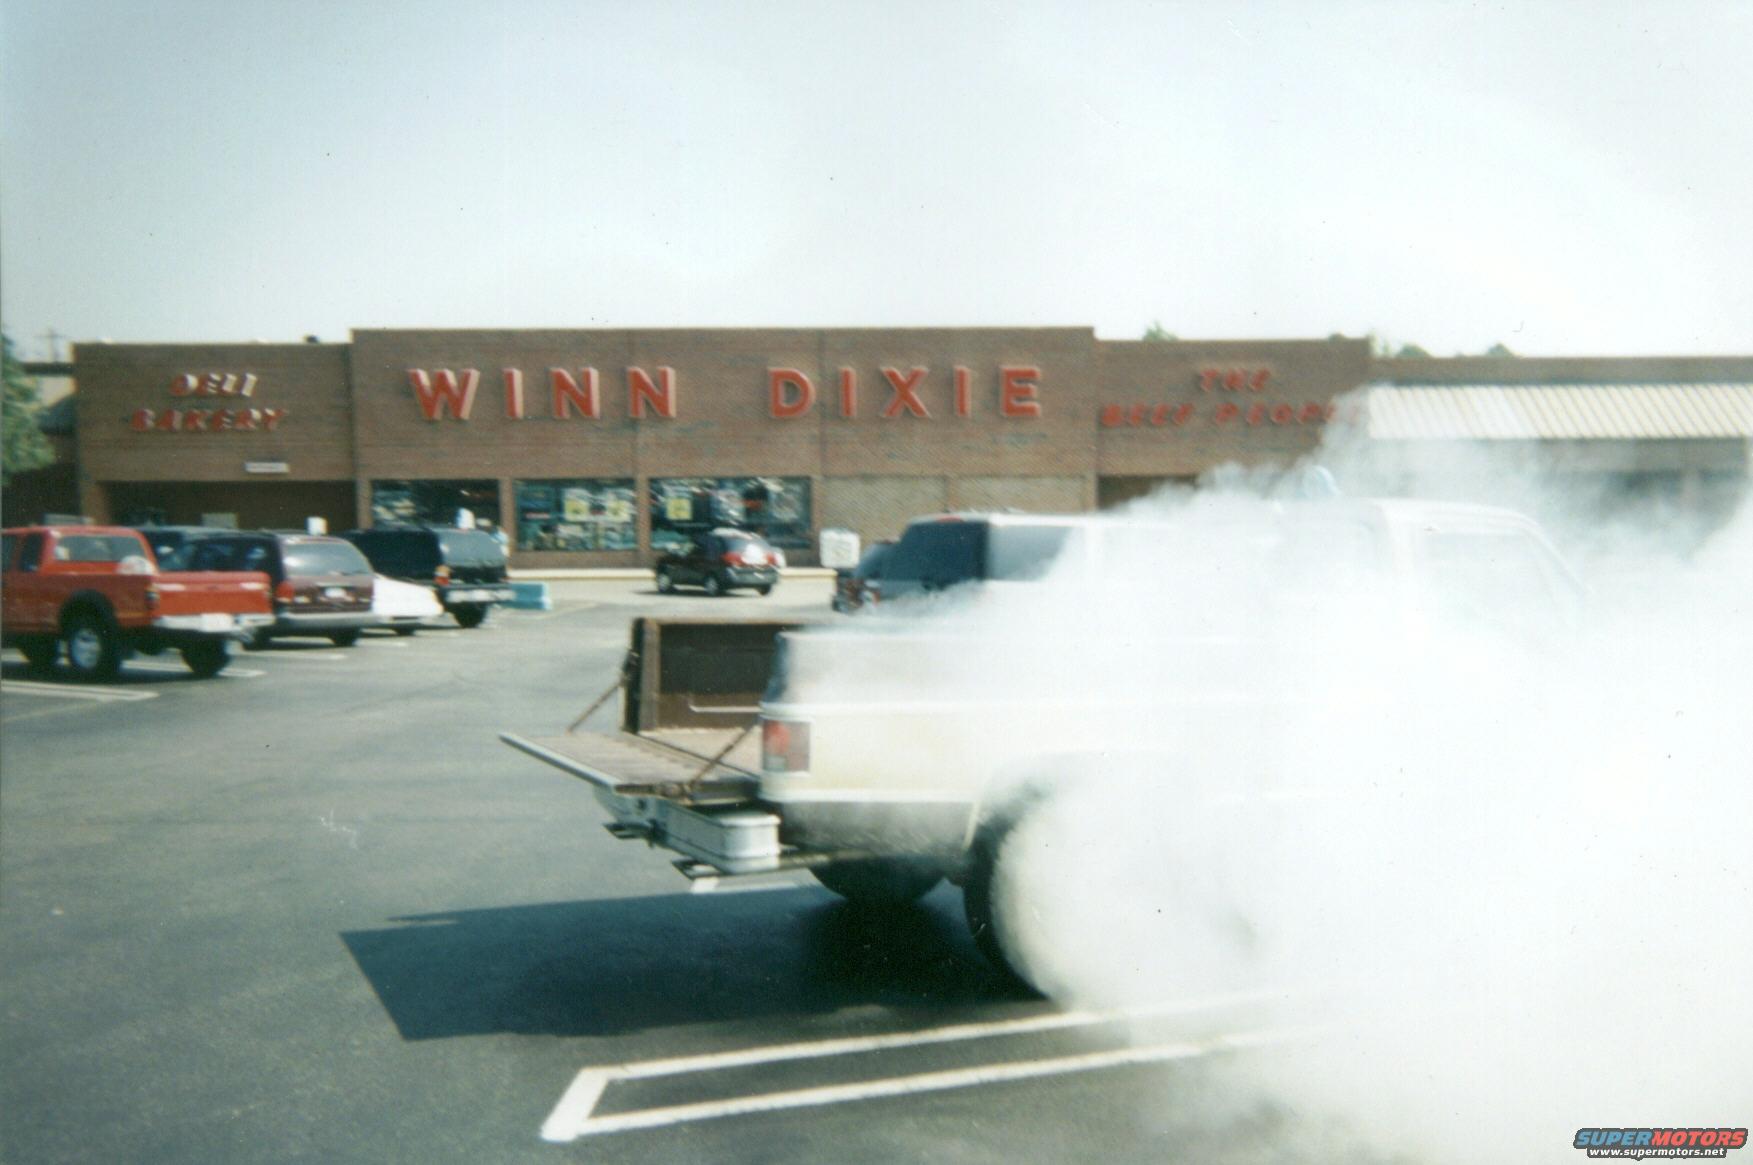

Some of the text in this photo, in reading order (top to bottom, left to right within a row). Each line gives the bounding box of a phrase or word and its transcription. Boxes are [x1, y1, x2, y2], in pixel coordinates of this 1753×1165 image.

[170, 372, 259, 397] DELI
[408, 365, 1043, 420] WINN DIXIE
[131, 407, 287, 432] BAKERY
